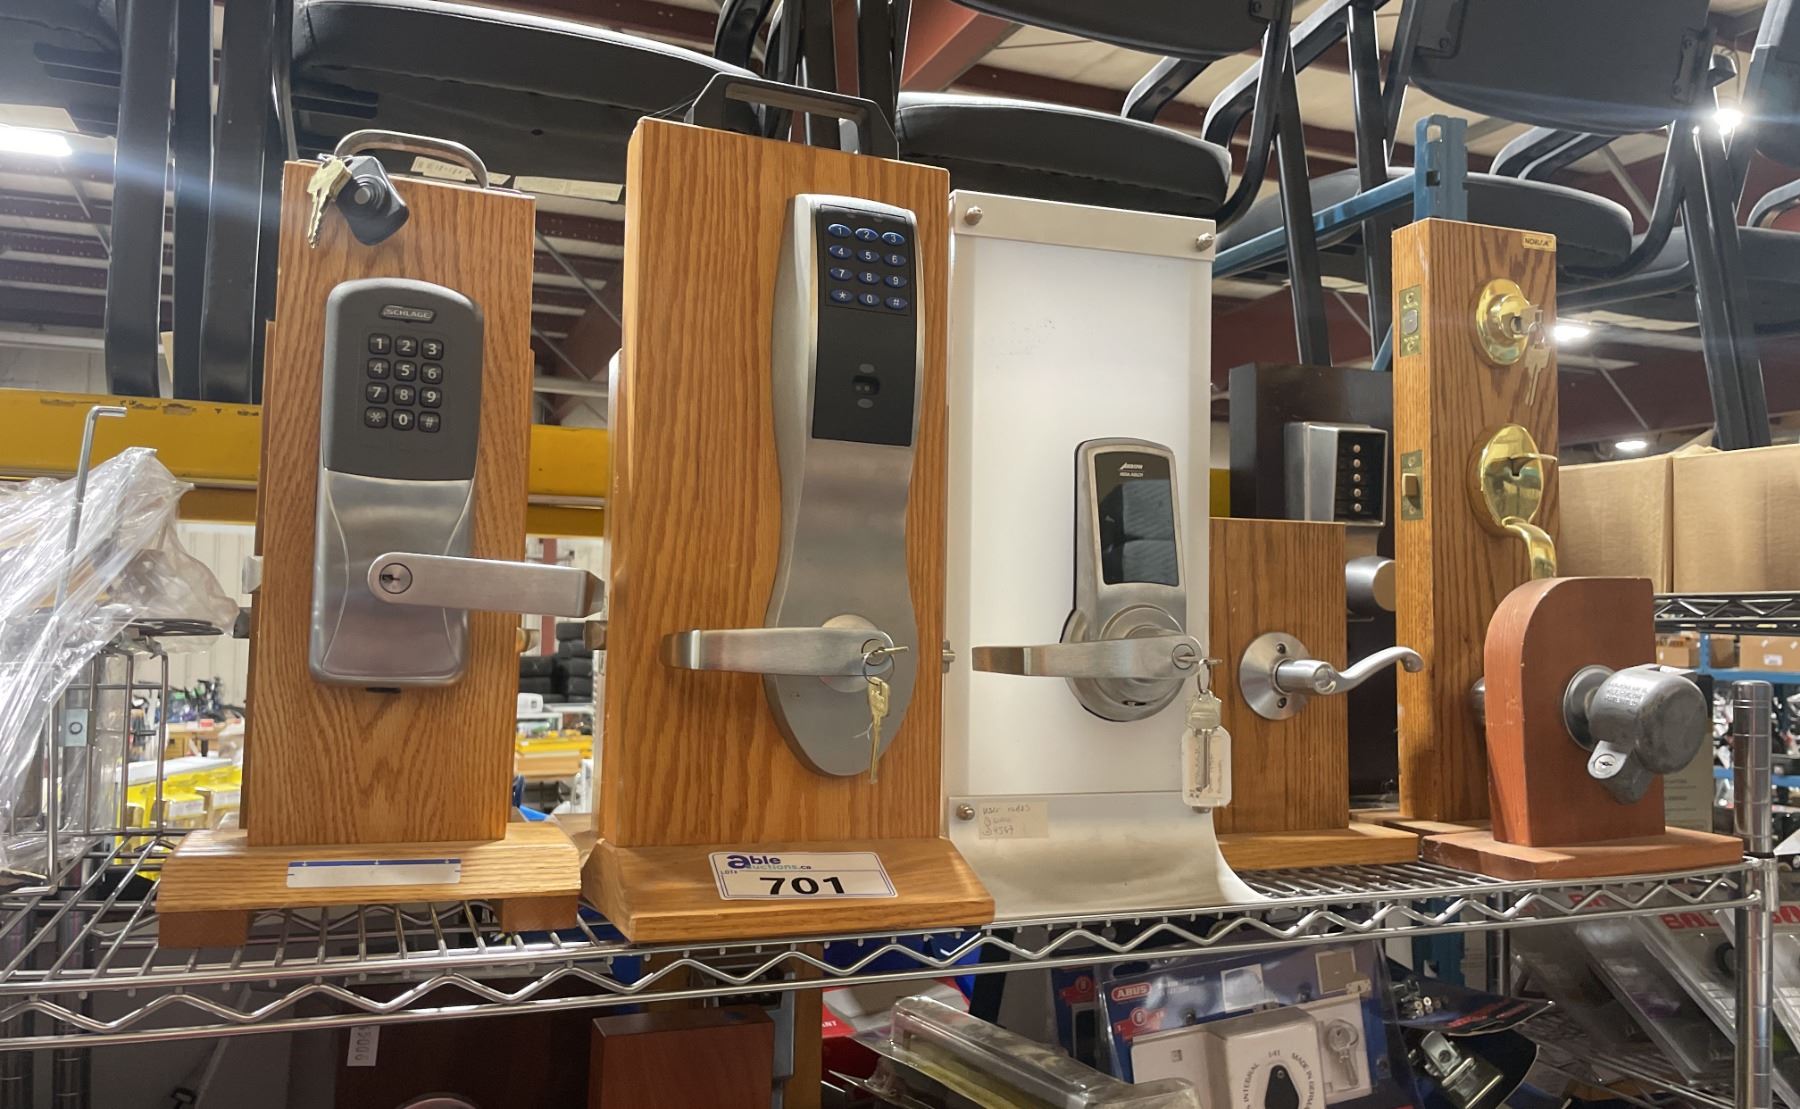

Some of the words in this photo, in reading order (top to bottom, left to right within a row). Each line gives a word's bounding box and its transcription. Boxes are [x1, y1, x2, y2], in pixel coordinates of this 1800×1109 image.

[864, 231, 870, 239] 2
[890, 235, 896, 243] 3
[838, 248, 844, 256] 4
[865, 252, 871, 260] 5
[891, 255, 897, 264] 6
[839, 269, 845, 277] 7
[866, 273, 872, 281] 8
[893, 277, 899, 285] 9
[866, 295, 873, 303] 0
[384, 308, 432, 318] SCHLAGE
[376, 338, 383, 350] 1
[402, 340, 411, 352] 2
[428, 343, 438, 355] 3
[373, 362, 383, 374] 4
[401, 365, 410, 376] 5
[427, 368, 437, 379] 6
[372, 386, 382, 398] 7
[399, 389, 409, 400] 8
[427, 391, 437, 402] 9
[398, 414, 408, 425] 0
[759, 876, 845, 895] 701
[1117, 985, 1147, 998] ABUS
